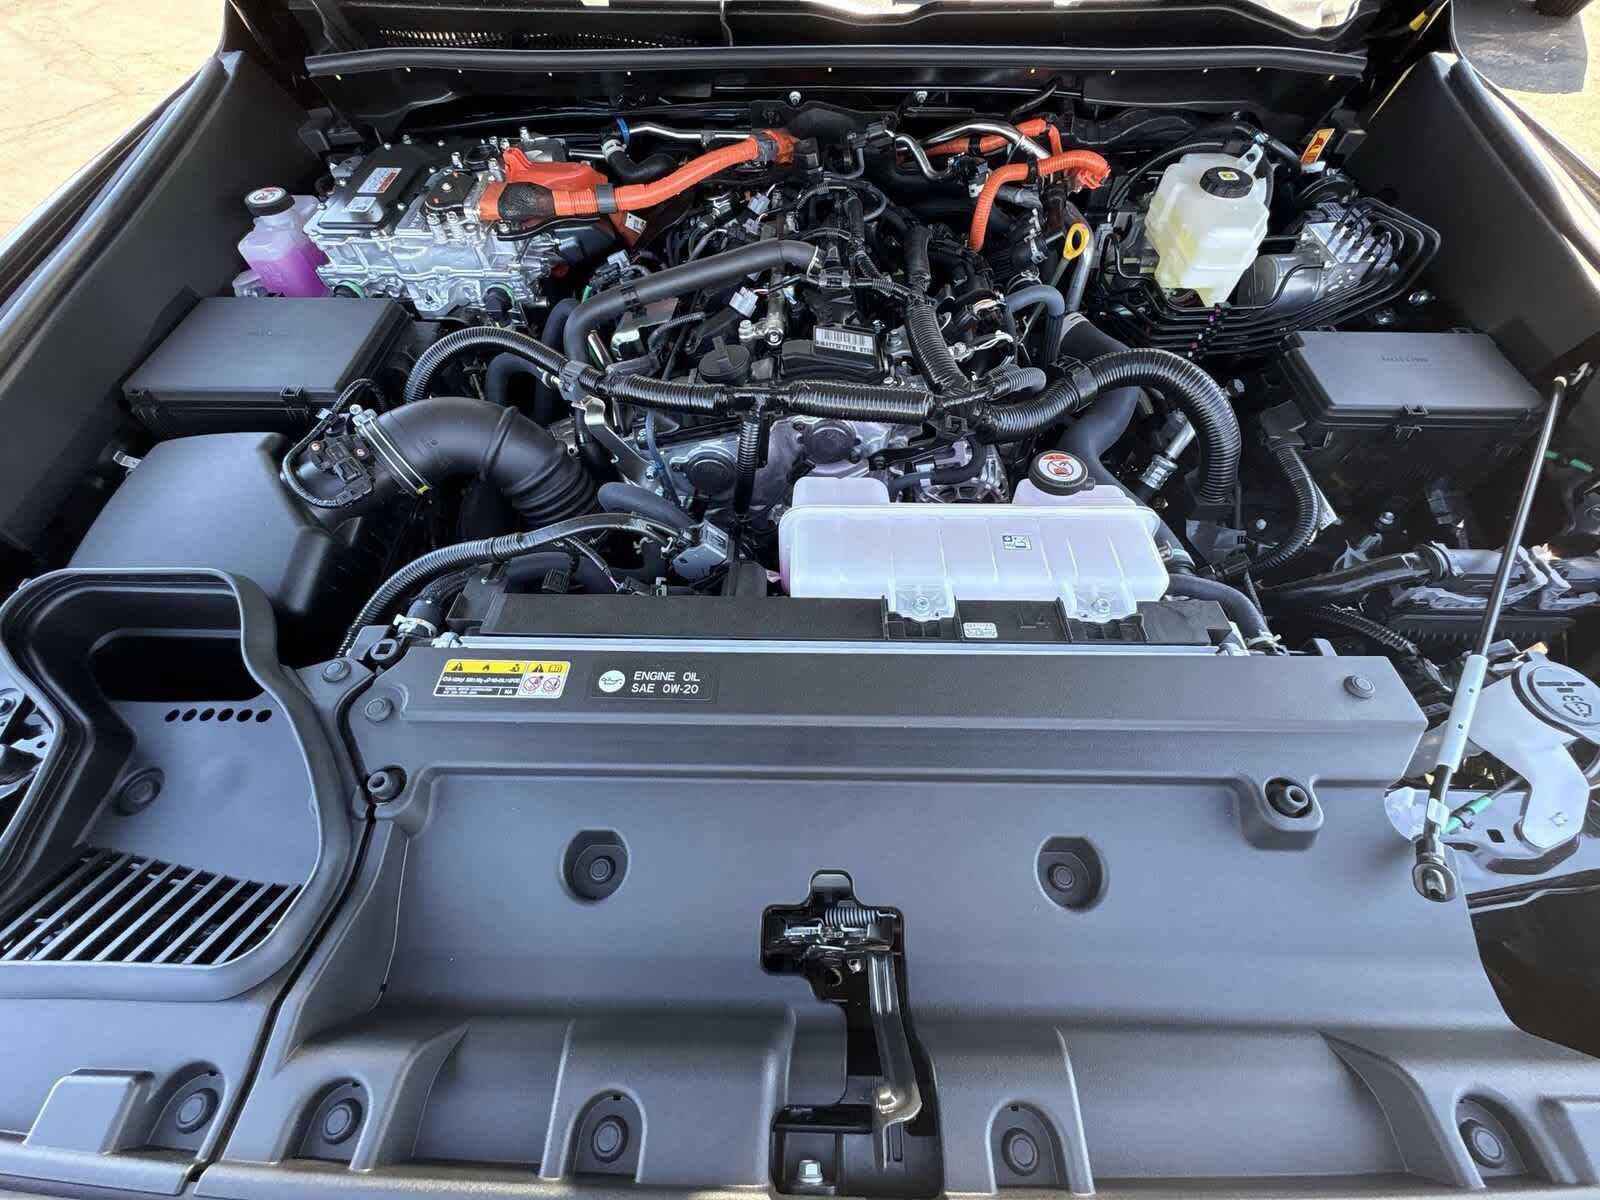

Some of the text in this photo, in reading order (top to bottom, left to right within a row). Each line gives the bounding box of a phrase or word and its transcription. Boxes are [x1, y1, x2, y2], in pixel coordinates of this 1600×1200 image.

[633, 671, 701, 682] ENGINE OIL
[631, 683, 699, 694] SAE 0W-20
